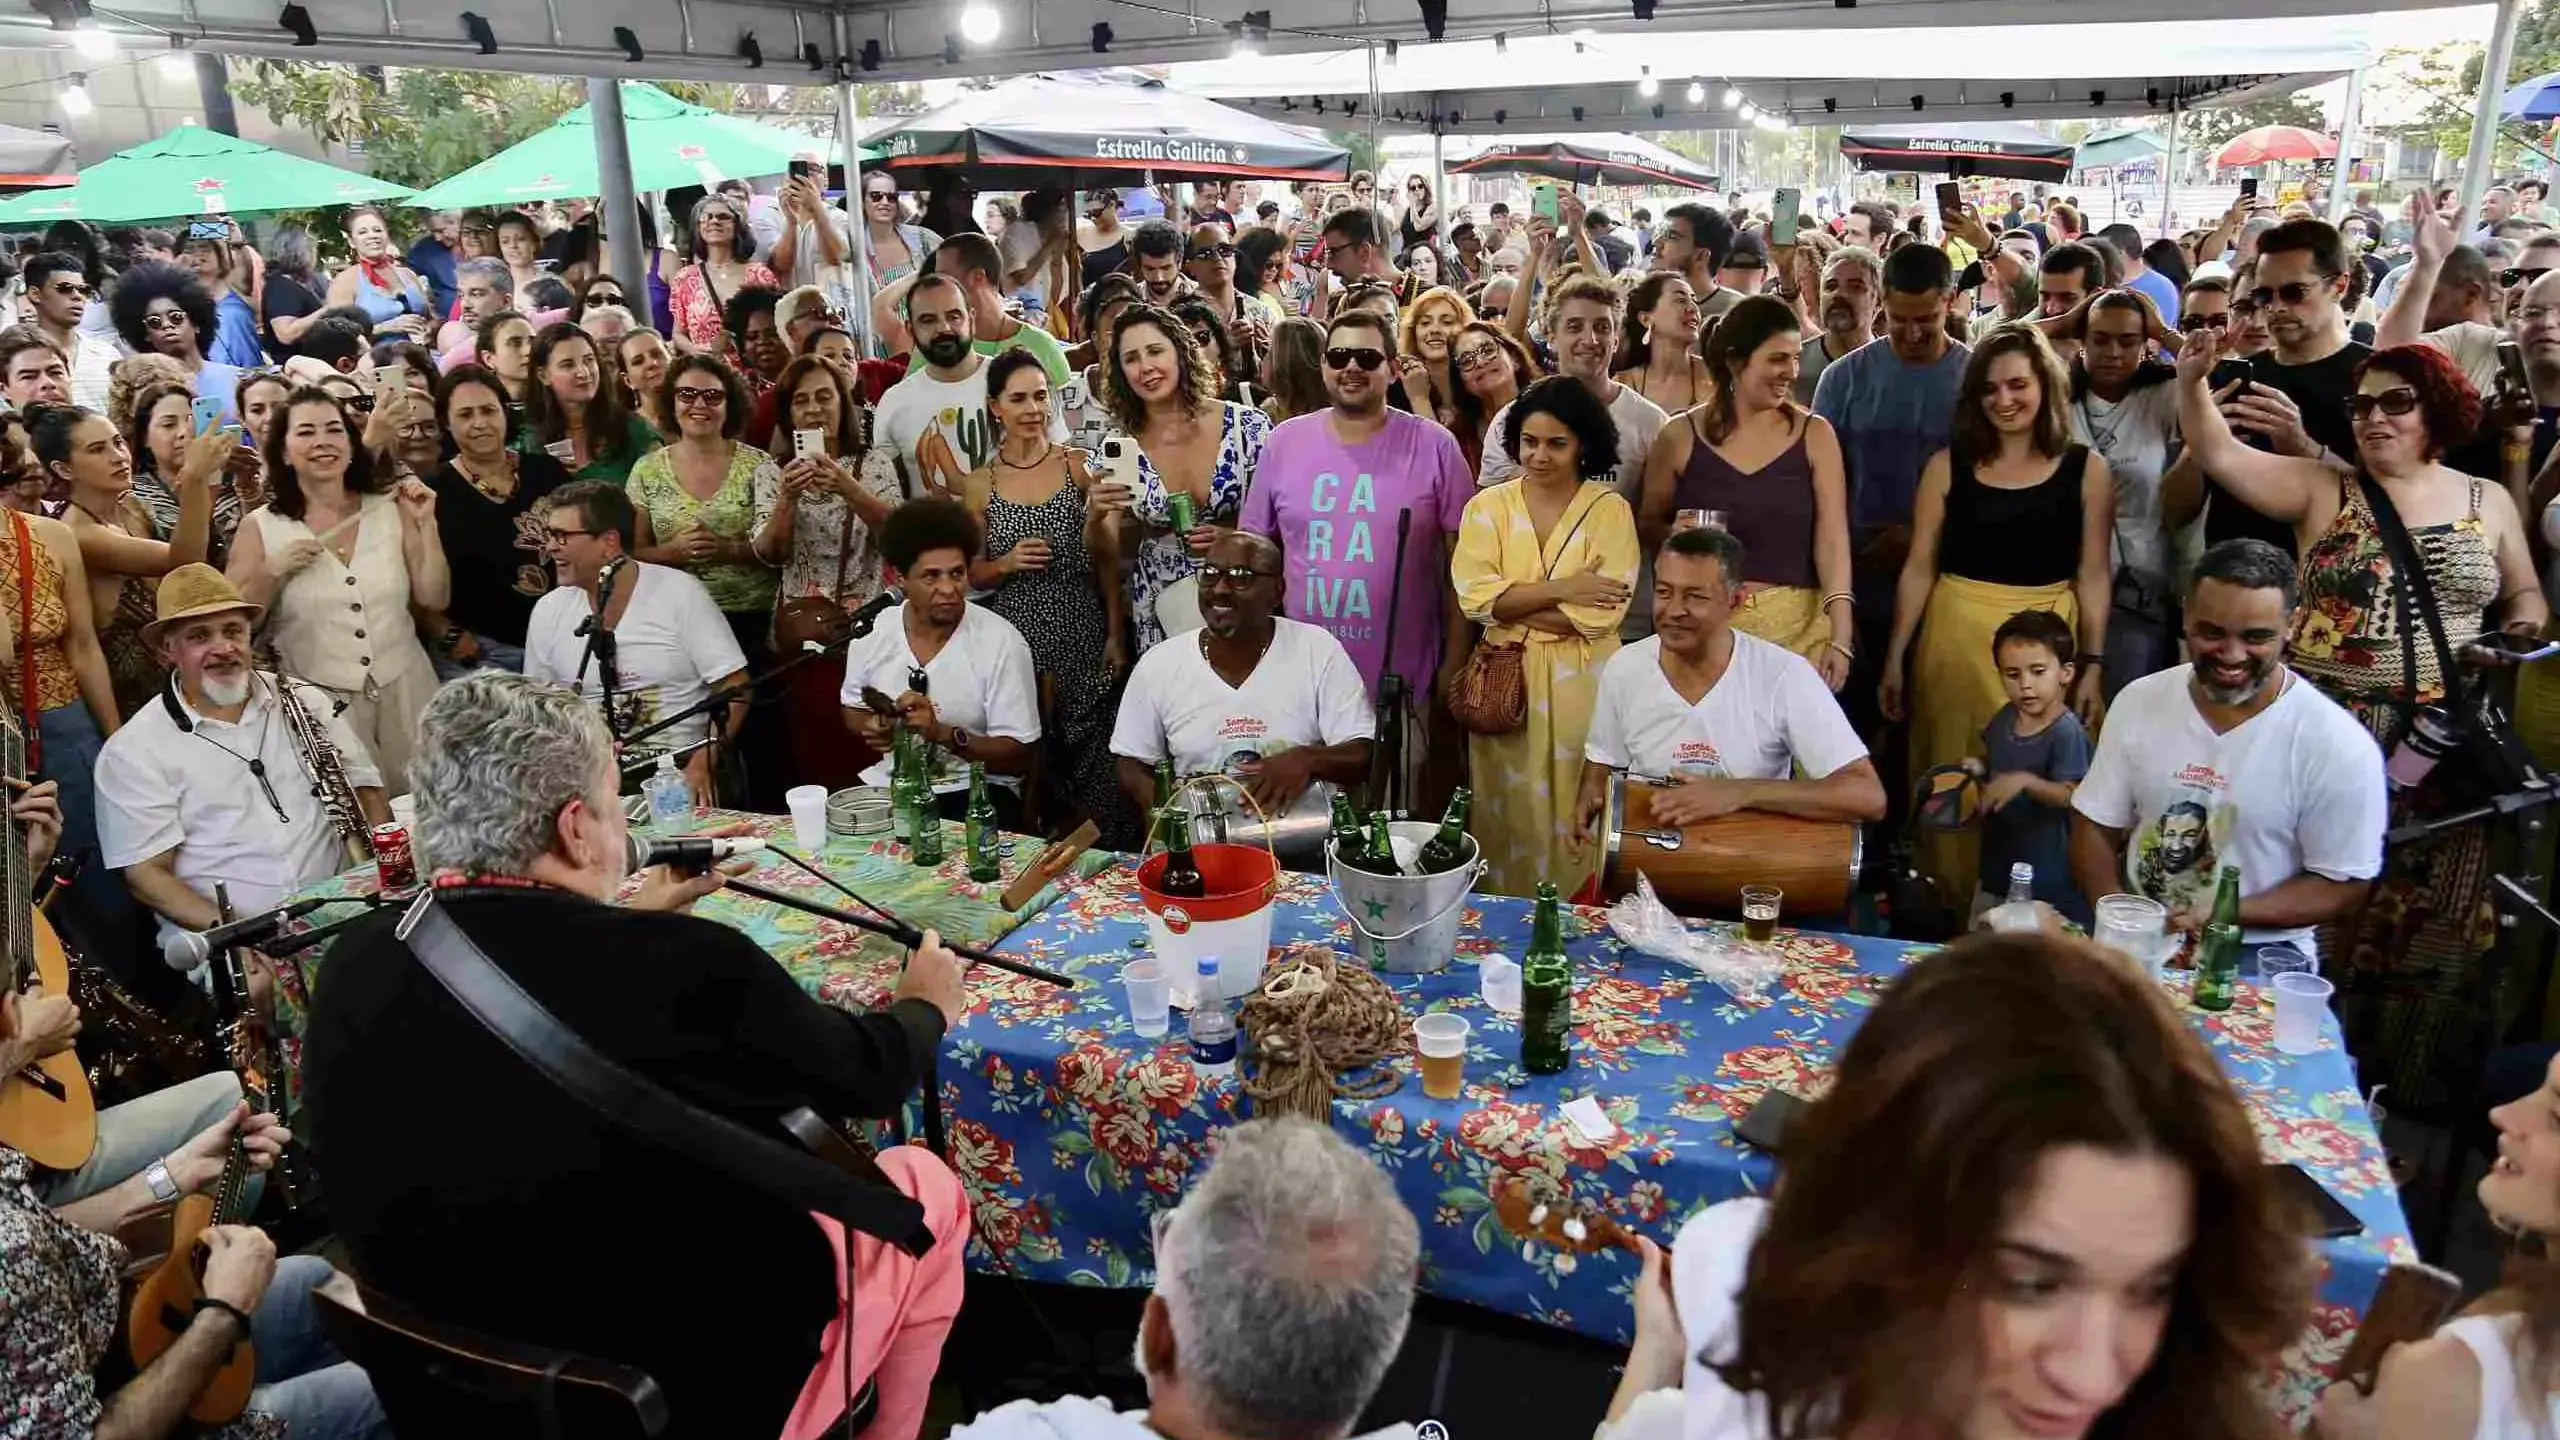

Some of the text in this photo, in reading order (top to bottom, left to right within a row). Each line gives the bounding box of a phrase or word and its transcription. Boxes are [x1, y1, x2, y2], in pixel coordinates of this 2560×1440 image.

[1096, 137, 1226, 163] Estrella Galicia
[1907, 138, 1989, 153] Estrella Galicia
